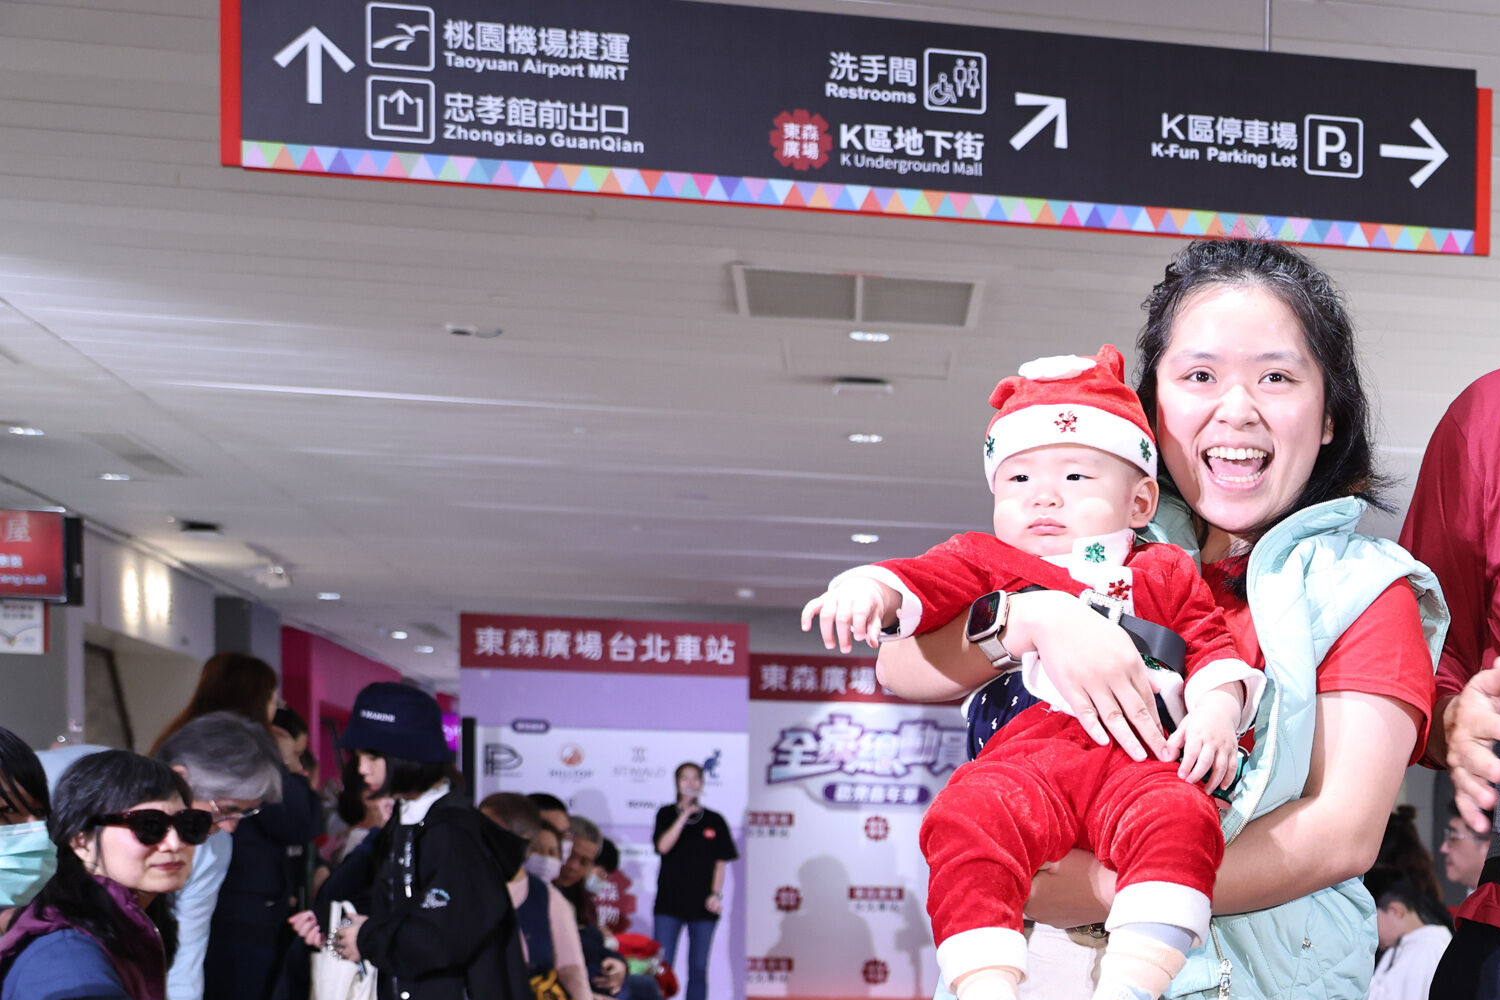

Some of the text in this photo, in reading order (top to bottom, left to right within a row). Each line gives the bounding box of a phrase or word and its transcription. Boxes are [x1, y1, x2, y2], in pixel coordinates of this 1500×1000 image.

[443, 19, 630, 63] 桃園機場捷運
[444, 51, 629, 81] Taoyuan Airport MRT
[828, 51, 917, 87] 洗手間
[825, 82, 917, 104] Restrooms
[444, 92, 629, 135] 忠孝館前出口
[443, 124, 645, 153] Zhongxiao GuanQian
[783, 122, 819, 141] 東森
[840, 123, 984, 161] K區地下街
[1161, 112, 1298, 150] K區停車場
[783, 140, 819, 160] 廣場
[840, 153, 983, 176] K Underground Mall
[1151, 142, 1297, 168] K-Fun Parking Lot
[474, 626, 735, 665] 東森廣場台北車站
[761, 664, 897, 696] 東森廣場
